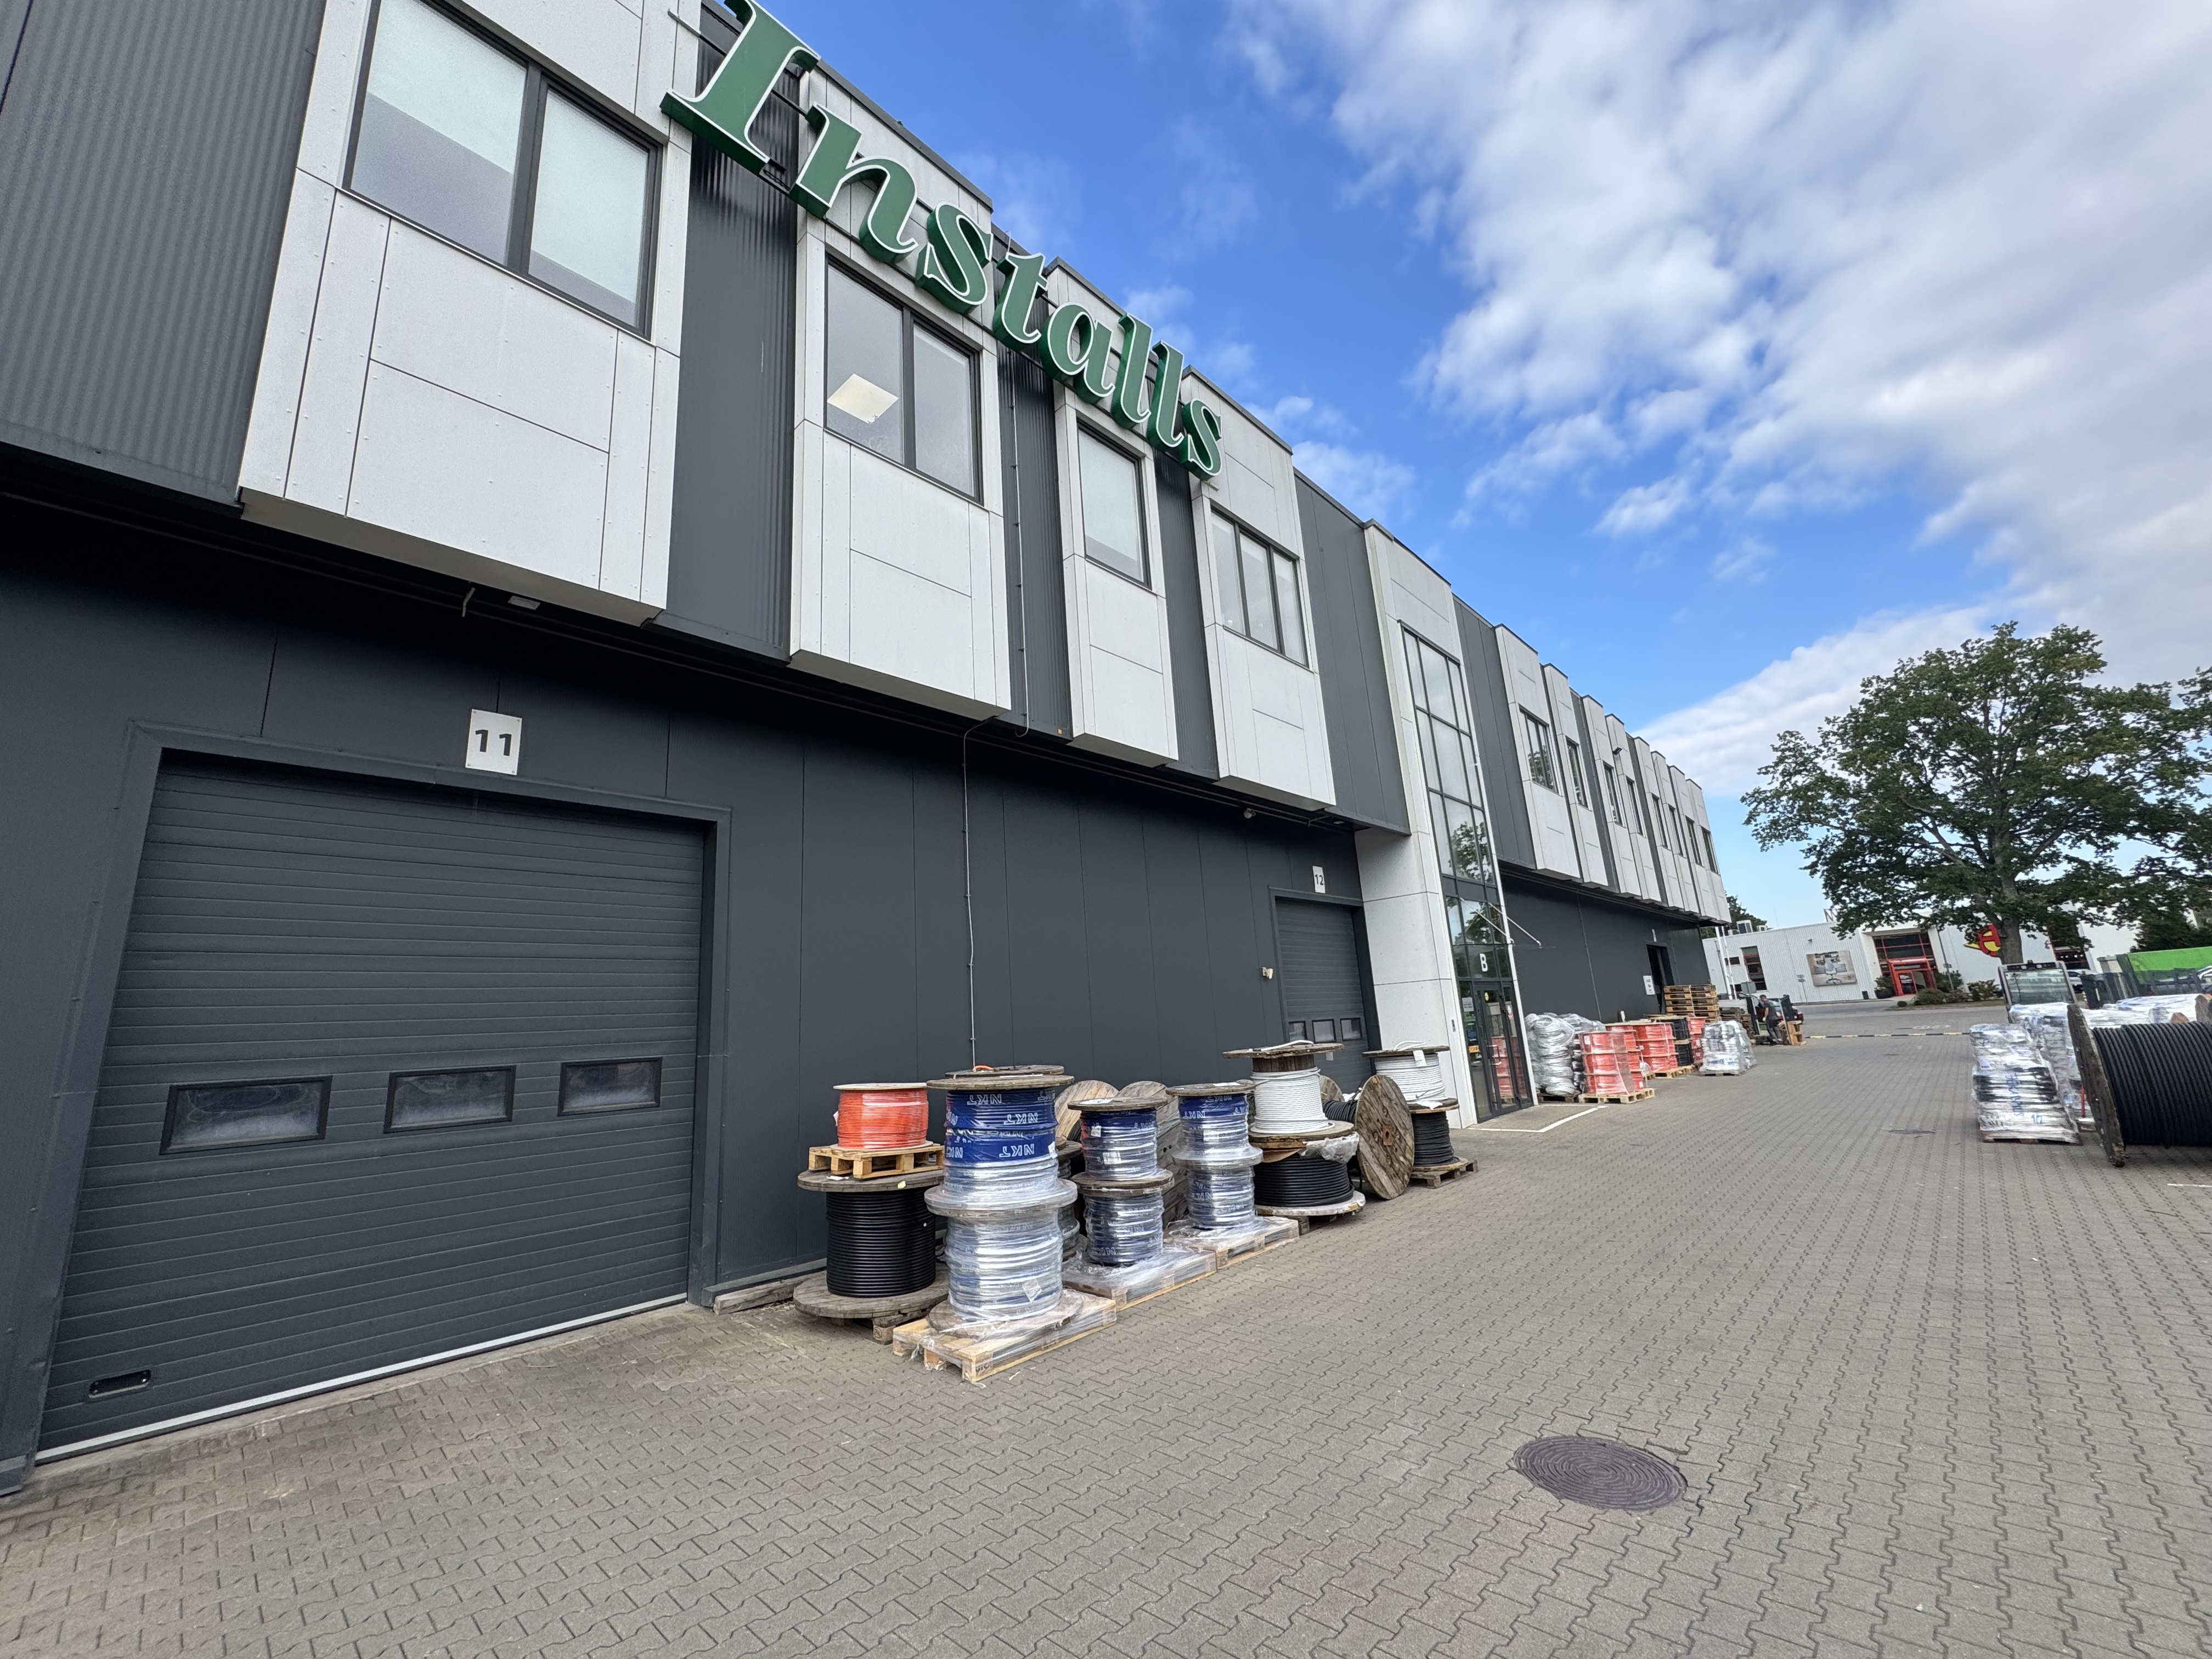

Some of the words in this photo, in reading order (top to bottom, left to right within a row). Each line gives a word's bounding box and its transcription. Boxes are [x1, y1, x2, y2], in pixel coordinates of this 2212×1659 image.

[659, 0, 1222, 479] Installs
[475, 729, 512, 757] 11
[1314, 874, 1324, 885] 12
[1479, 953, 1488, 972] B
[967, 1094, 1002, 1105] NKT
[1003, 1113, 1039, 1125] NKT
[999, 1143, 1035, 1158] NKT
